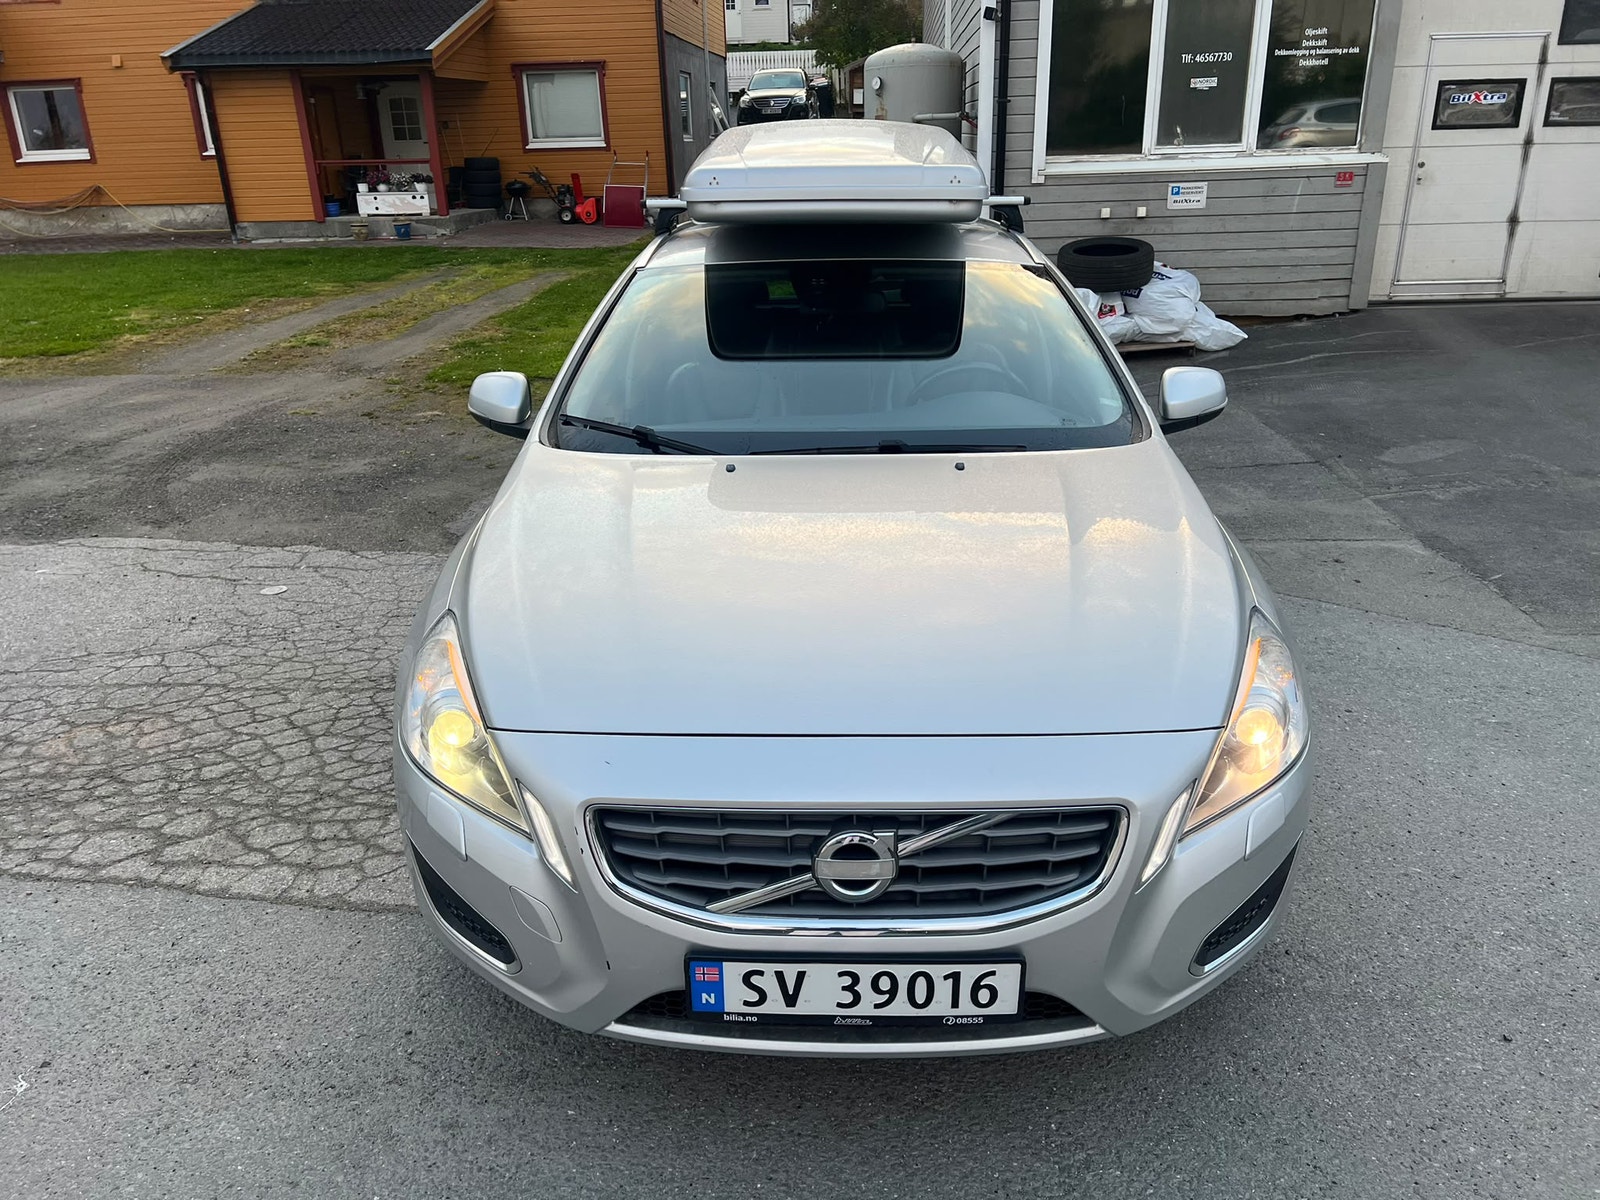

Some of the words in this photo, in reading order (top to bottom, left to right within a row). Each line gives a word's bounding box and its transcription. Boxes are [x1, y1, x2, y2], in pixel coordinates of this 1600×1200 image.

[1304, 27, 1328, 37] Oljeskift
[1302, 38, 1328, 47] Dekkskift
[1181, 53, 1194, 63] Tlf:
[1195, 51, 1233, 62] 46567730
[1299, 57, 1329, 66] Dekkhotell
[1450, 90, 1507, 104] BilXtra
[1172, 187, 1179, 195] P
[741, 969, 807, 1009] SV
[835, 969, 999, 1010] 39016
[701, 992, 715, 1004] N
[723, 1013, 758, 1022] bilia.no
[956, 1016, 984, 1024] 08555
